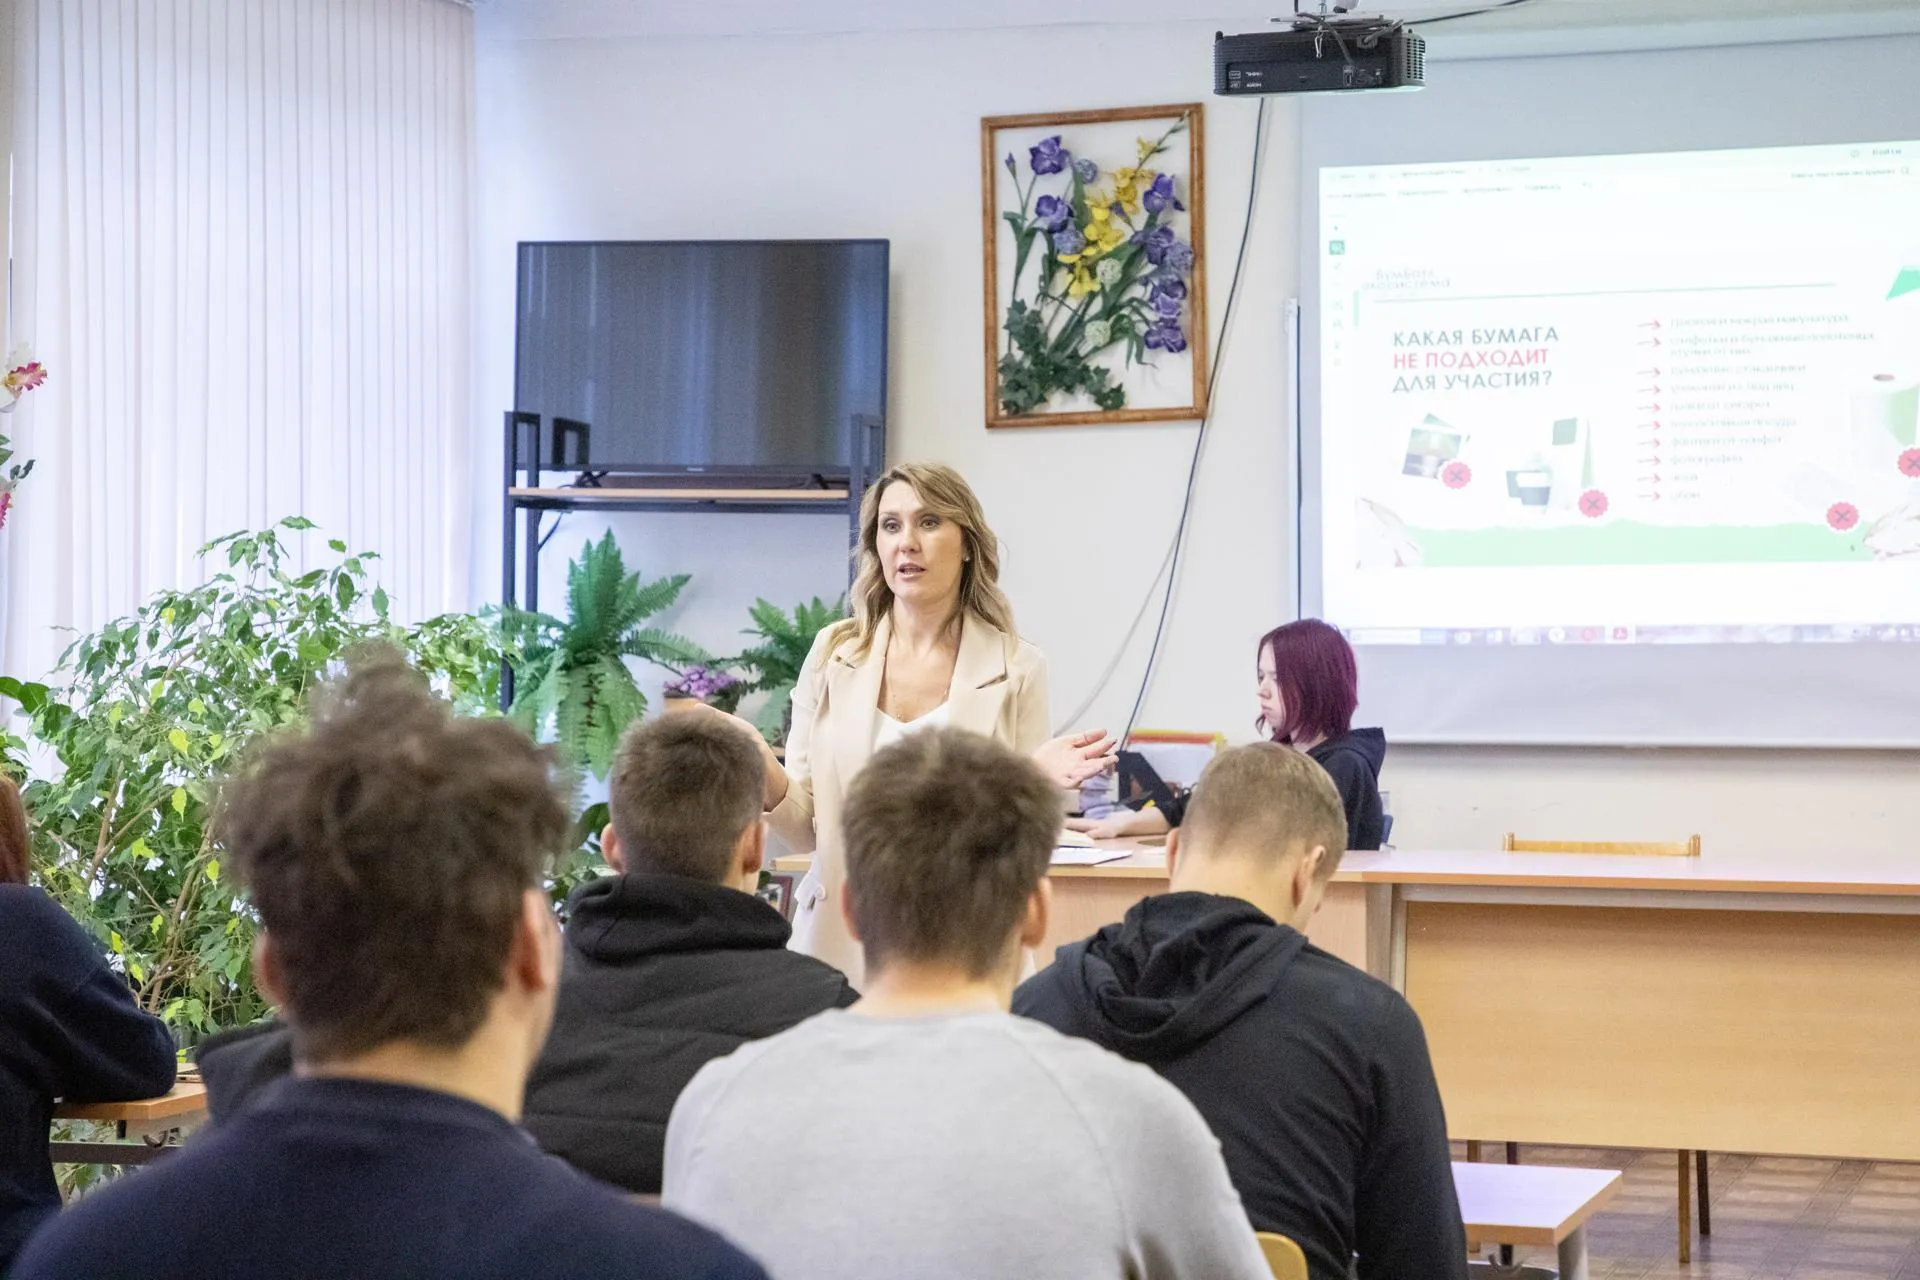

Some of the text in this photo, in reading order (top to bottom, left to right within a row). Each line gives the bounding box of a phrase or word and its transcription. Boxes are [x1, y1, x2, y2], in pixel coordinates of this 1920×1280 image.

[1393, 326, 1559, 347] КАКАЯ БУМАГА
[1393, 348, 1549, 369] НЕ ПОДХОДИТ
[1392, 370, 1553, 393] ДЛЯ УЧАСТИЯ?
